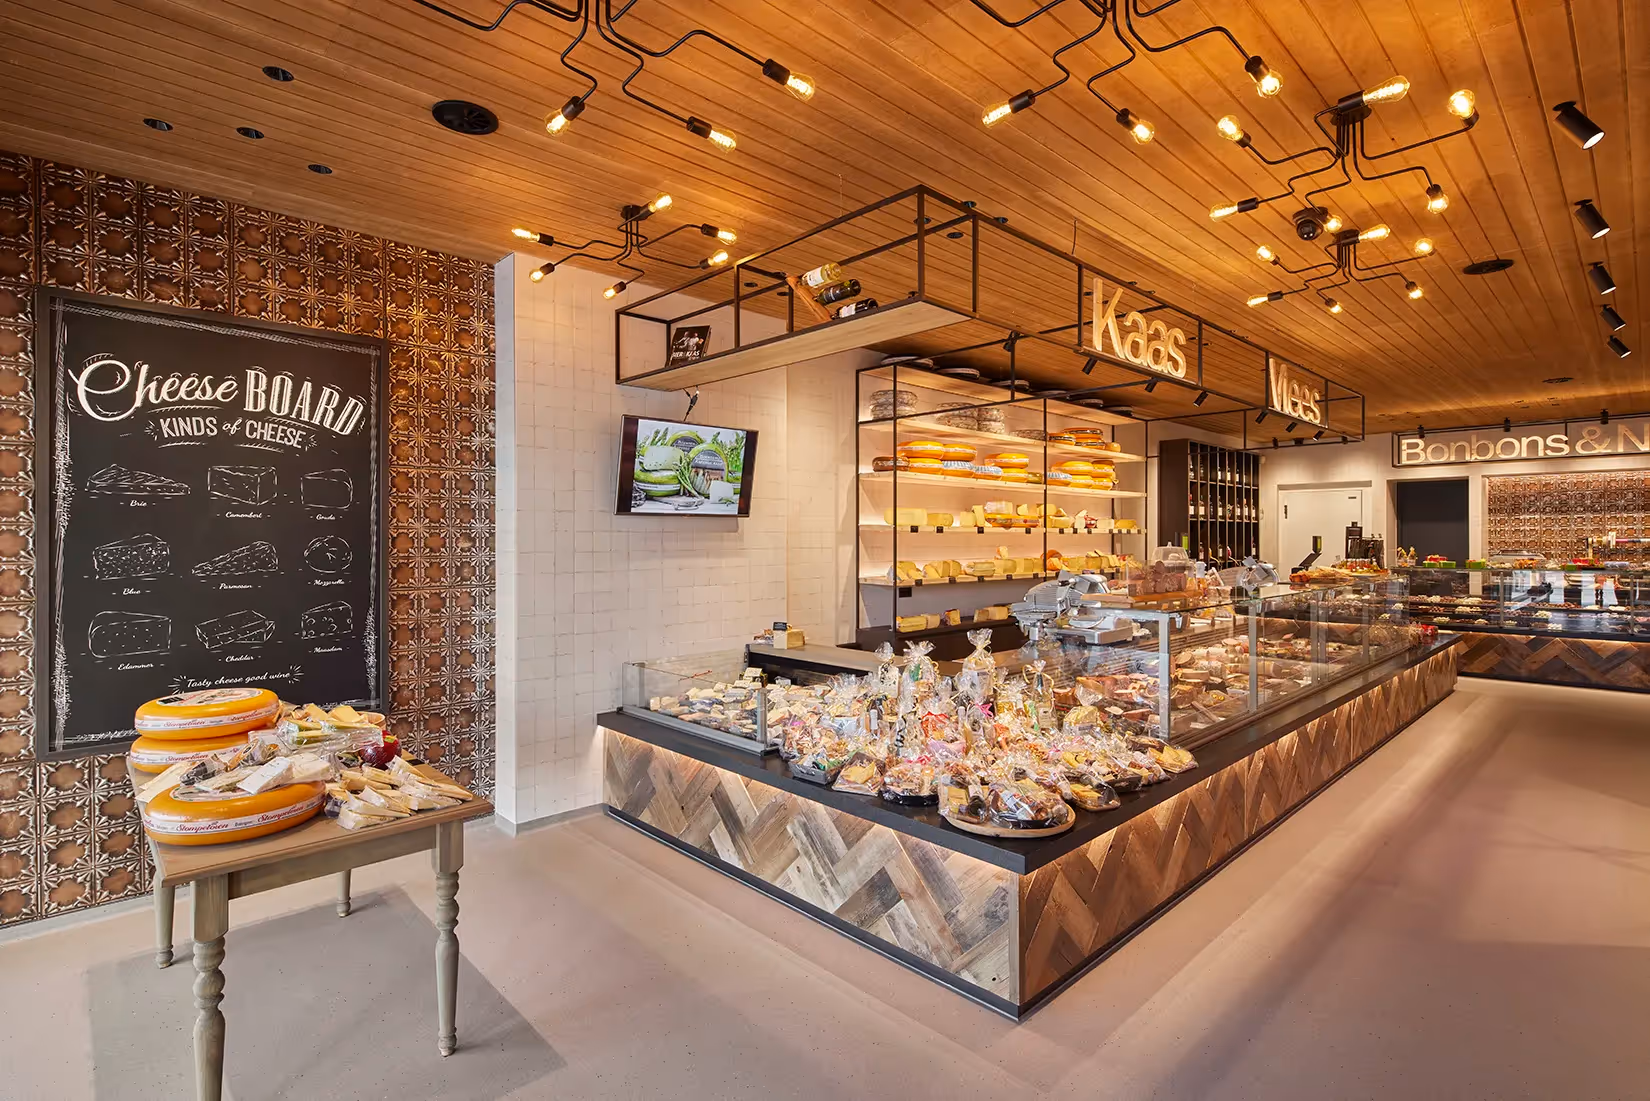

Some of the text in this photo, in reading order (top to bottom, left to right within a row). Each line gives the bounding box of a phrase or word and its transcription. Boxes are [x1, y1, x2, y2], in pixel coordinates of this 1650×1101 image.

[1093, 278, 1186, 379] Kaas
[68, 360, 364, 436] Cheese BOARD
[160, 417, 307, 449] KINDS of CHEESE
[1401, 433, 1570, 464] Bonbons
[1575, 426, 1612, 454] &
[187, 679, 212, 687] Tasty
[214, 676, 243, 684] cheese
[245, 672, 268, 683] good
